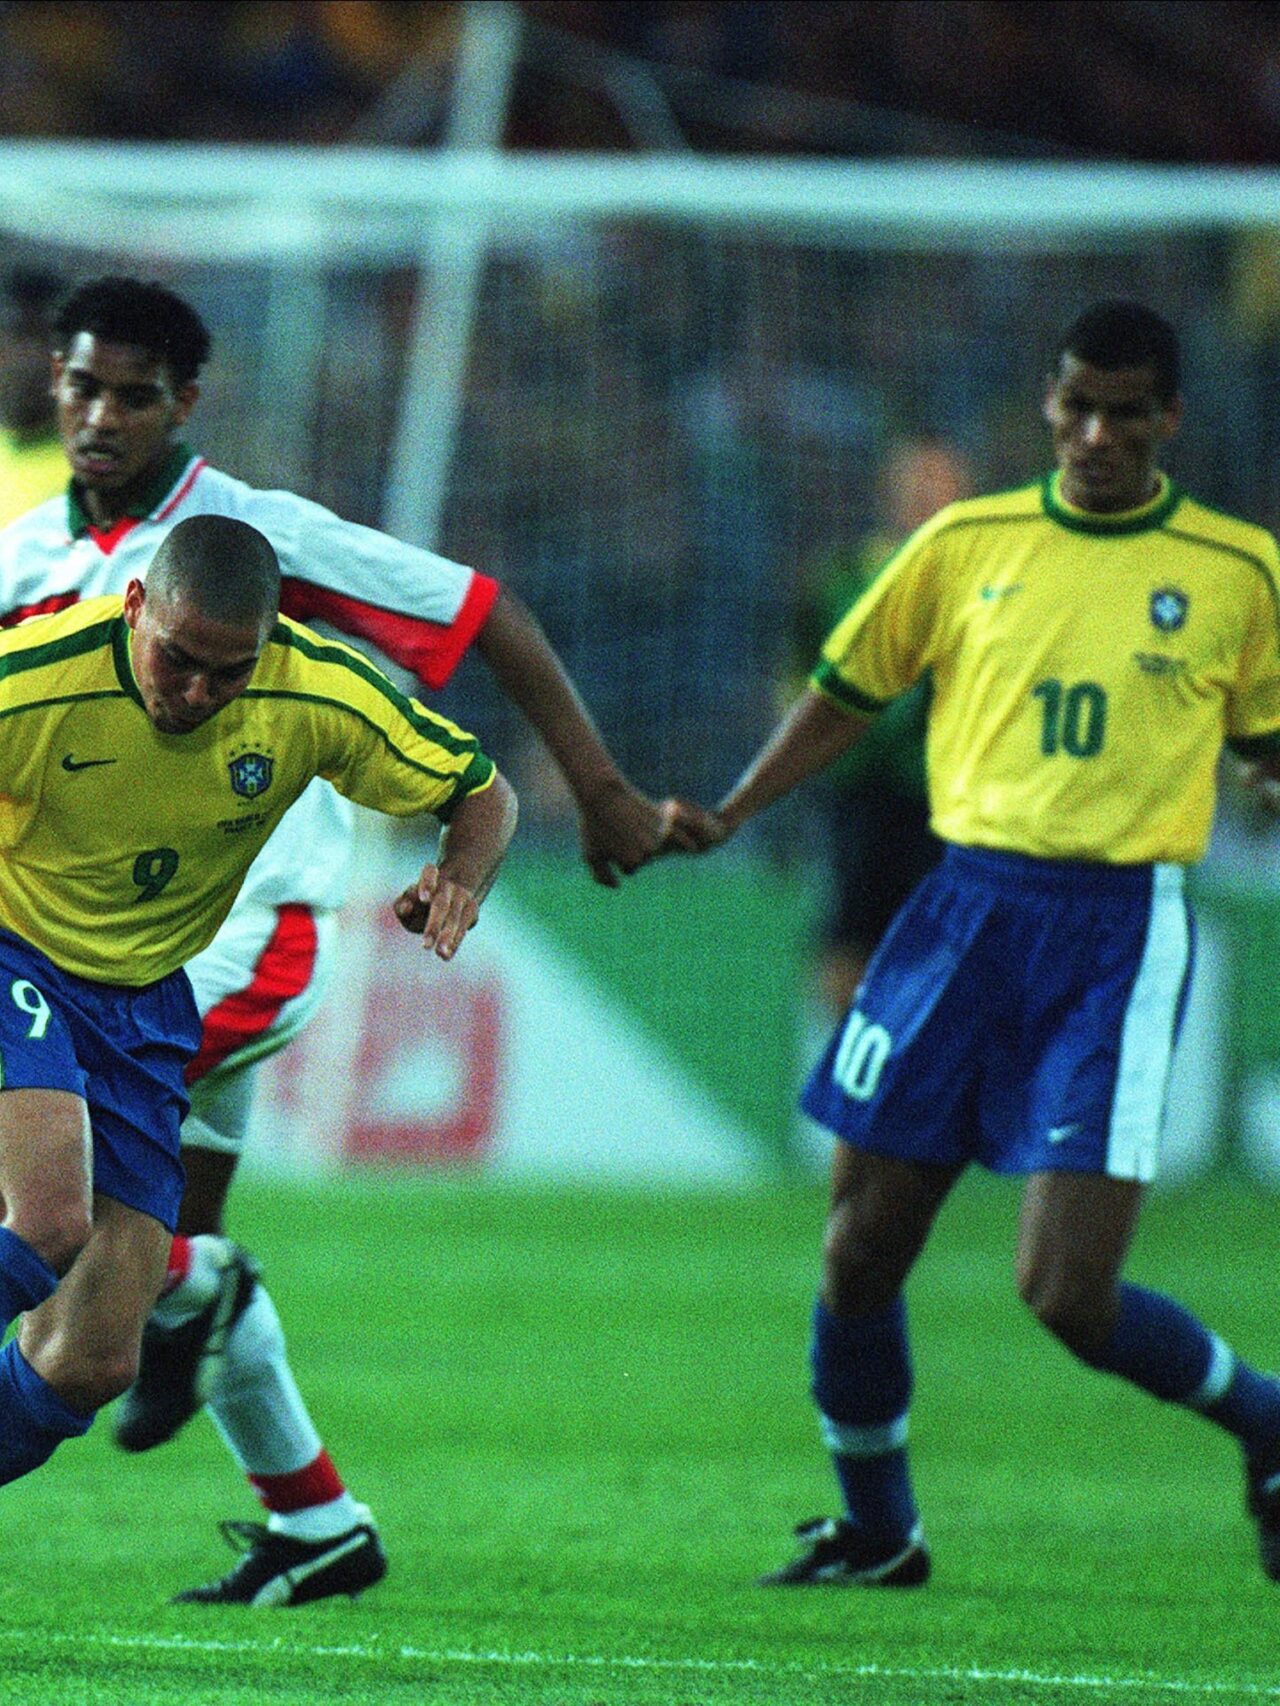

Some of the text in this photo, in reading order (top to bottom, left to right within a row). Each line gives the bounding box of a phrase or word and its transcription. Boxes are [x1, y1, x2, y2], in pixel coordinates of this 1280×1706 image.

[1031, 677, 1107, 759] 10
[132, 847, 179, 902] 9
[11, 979, 52, 1039] 9
[833, 1009, 891, 1100] 10
